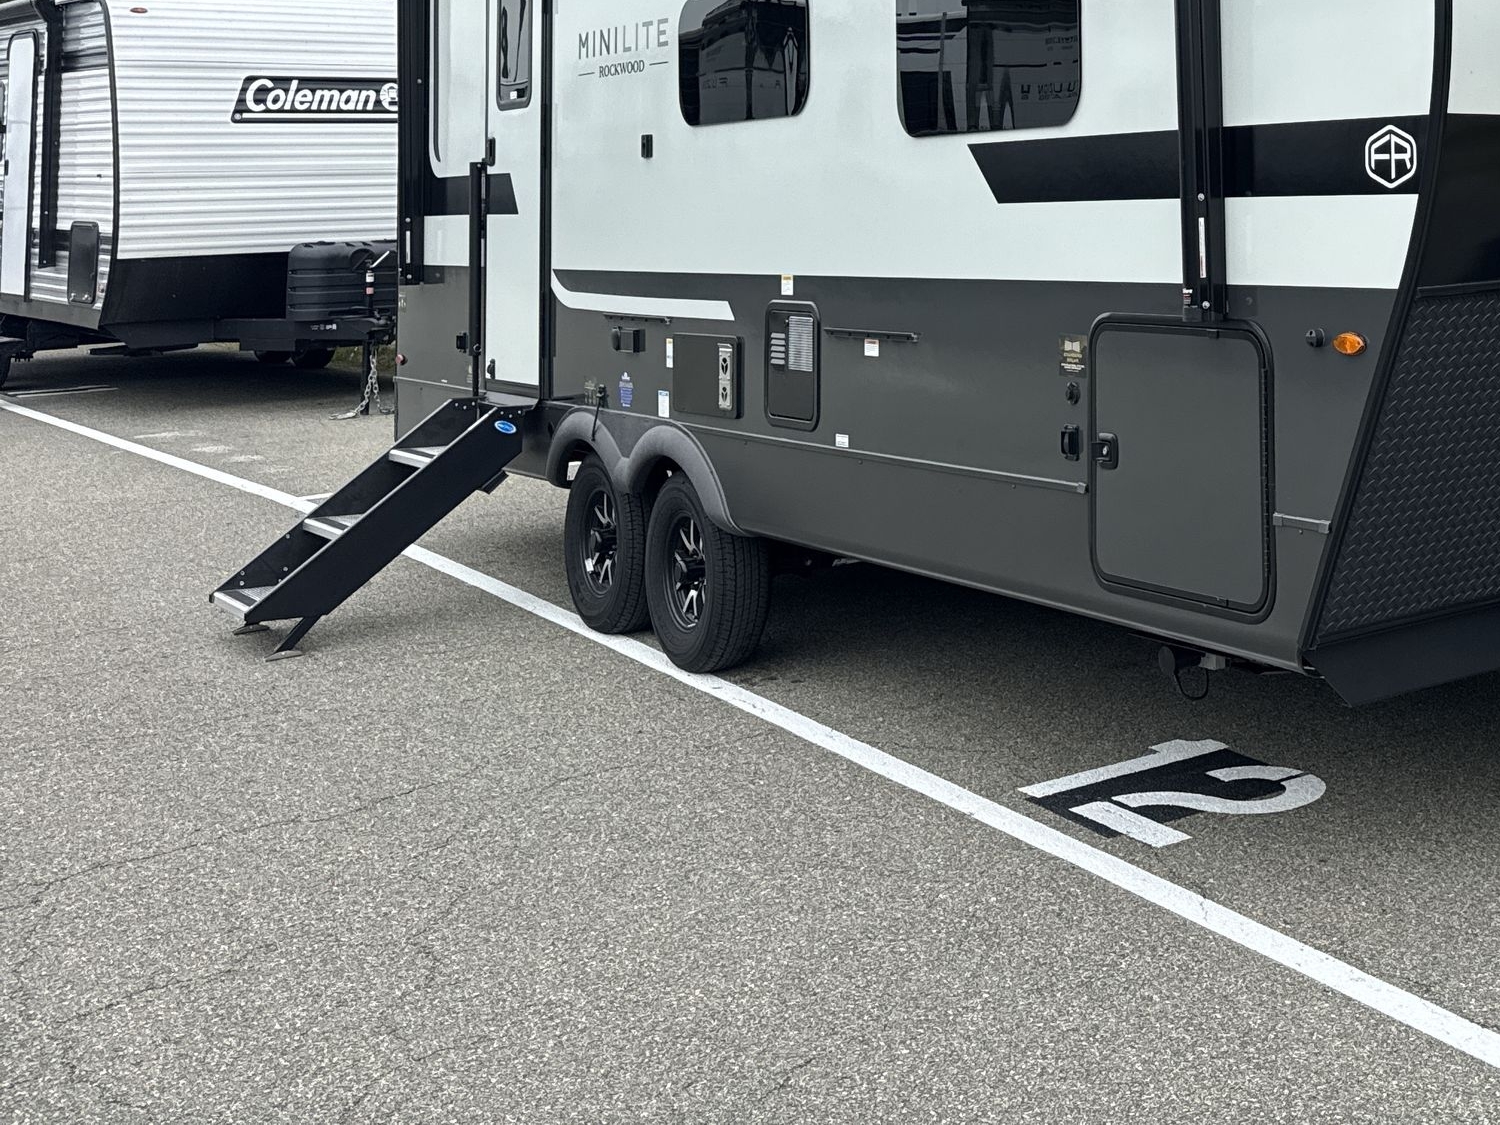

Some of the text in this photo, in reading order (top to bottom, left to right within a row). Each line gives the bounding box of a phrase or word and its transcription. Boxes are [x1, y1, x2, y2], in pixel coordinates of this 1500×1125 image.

[578, 17, 669, 60] MINILITE
[598, 59, 645, 78] ROCKWOOD
[245, 78, 377, 112] Coleman
[1017, 739, 1327, 849] 12
